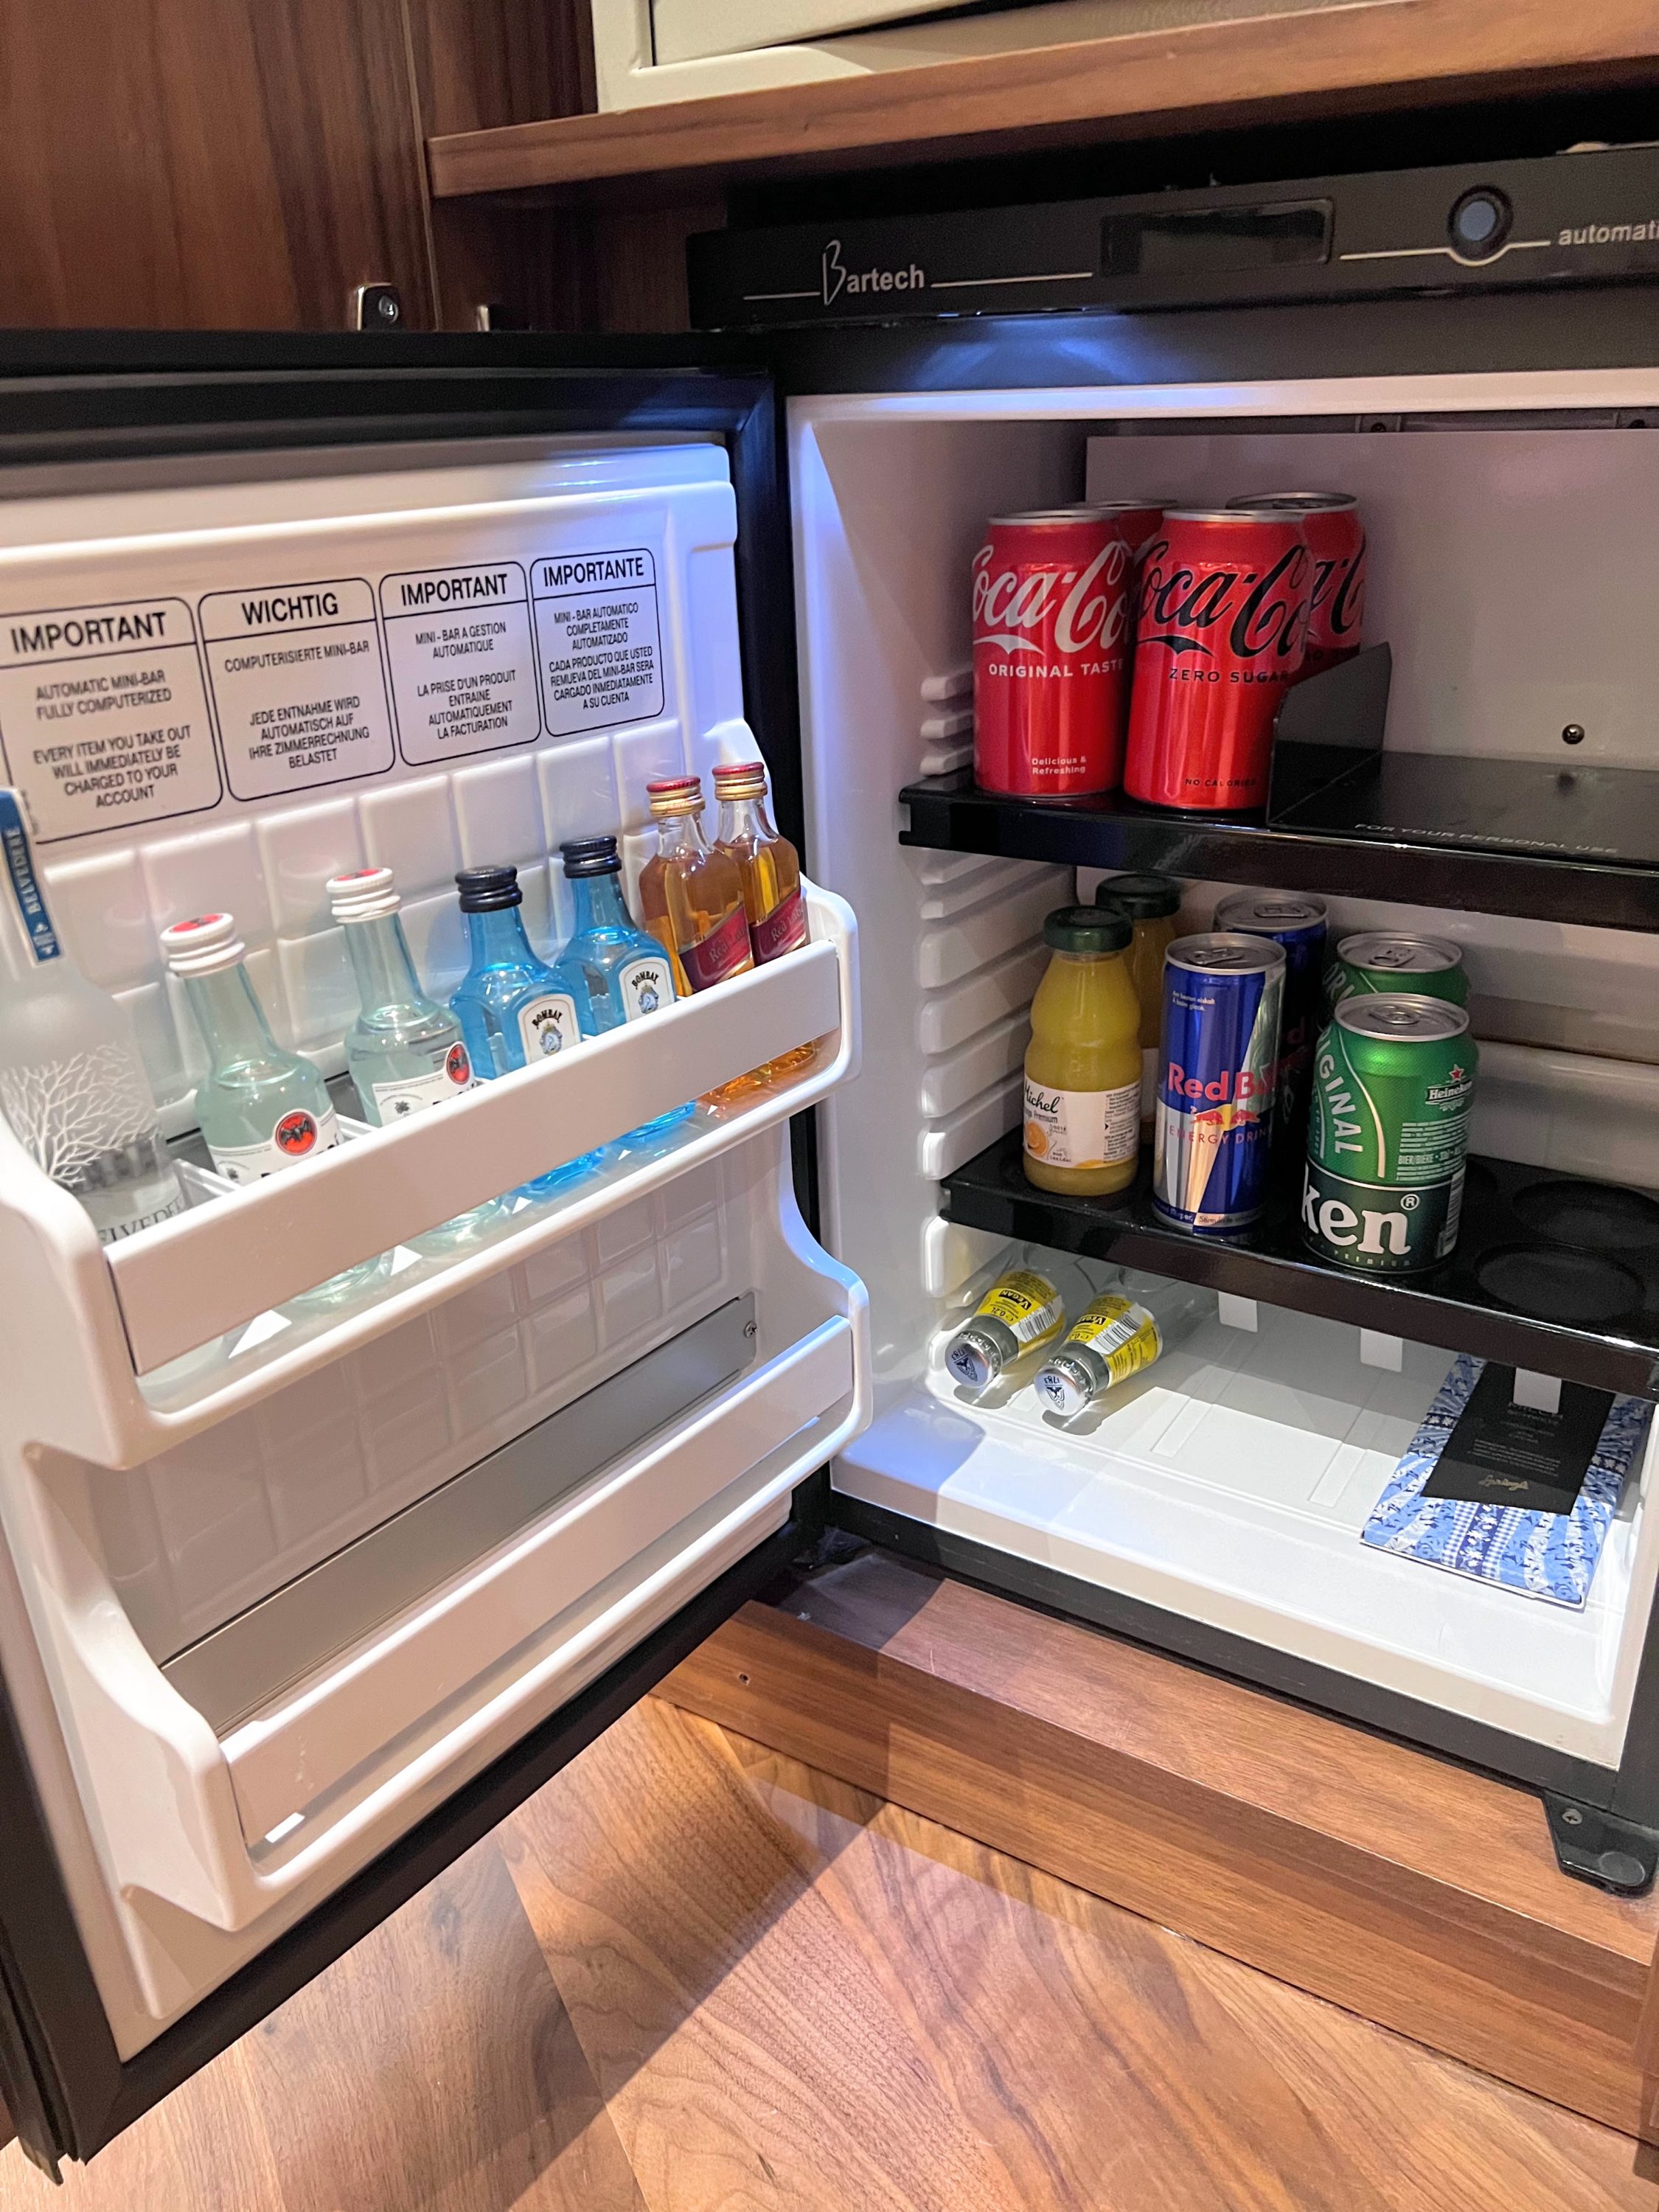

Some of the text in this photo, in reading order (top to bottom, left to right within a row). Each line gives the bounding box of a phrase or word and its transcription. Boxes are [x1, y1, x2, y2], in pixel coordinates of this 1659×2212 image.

[822, 240, 925, 306] Bartech
[543, 557, 644, 587] IMPORTANTE
[400, 574, 508, 606] IMPORTANT
[242, 592, 338, 625] WICHTIG
[554, 610, 571, 624] MINI
[576, 606, 591, 621] BAR
[591, 602, 639, 619] AUTOMATICO
[11, 611, 166, 653] IMPORTANT
[415, 631, 436, 645] MINI
[442, 627, 462, 642] BAR
[462, 626, 468, 639] A
[469, 621, 507, 638] GESTION
[566, 618, 629, 637] COMPLETAMENTE
[432, 639, 494, 659] AUTOMATIQUE
[571, 633, 628, 651] AUTOMATIZADO
[225, 639, 370, 672] COMPUTERISIERTE MINI-BAR
[549, 646, 653, 673] CADA PRODUCTO QUE USTED
[550, 660, 654, 687] REMUEVA DEL MINI-BAR SERA
[989, 663, 1073, 678] ORIGINAL
[1169, 668, 1220, 684] ZERO
[37, 669, 166, 701] AUTOMATIC MINI-BAR
[417, 669, 516, 698] LA PRISE D'UN PRODUIT
[554, 673, 653, 700] CARGADO INMEDIATAMENTE
[37, 688, 172, 721] FULLY COMPUTERIZED
[448, 689, 490, 707] ENTRAINE
[582, 692, 630, 710] A SU CUENTA
[250, 695, 361, 726] JEDE ENTNAHME WIRD
[428, 700, 513, 726] AUTOMATIQUEMENT
[260, 712, 354, 741] AUTOMATISCH AUF
[437, 716, 508, 740] LA FACTURATION
[33, 724, 192, 765] EVERY ITEM YOU TAKE OUT
[248, 726, 370, 760] IHRE ZIMMERRECHNUNG
[52, 744, 181, 779] WILL IMMEDIATELY BE
[288, 748, 338, 768] BELASTET
[1032, 757, 1077, 765] Delicious
[1032, 765, 1086, 775] Refreshing
[64, 762, 178, 796] CHARGED TO YOUR
[1185, 778, 1200, 786] NO
[95, 785, 155, 808] ACCOUNT
[1354, 824, 1618, 855] FOR YOUR PERSONAL USE
[771, 921, 787, 942] Red
[631, 970, 659, 990] BOMBAY
[532, 1009, 563, 1029] BOMBAY
[1168, 1062, 1228, 1102] Red
[1169, 1125, 1270, 1144] ENERGY DRIN
[1001, 1290, 1029, 1310] VEGAN
[951, 1348, 967, 1361] 1783
[1043, 1375, 1060, 1385] 1783
